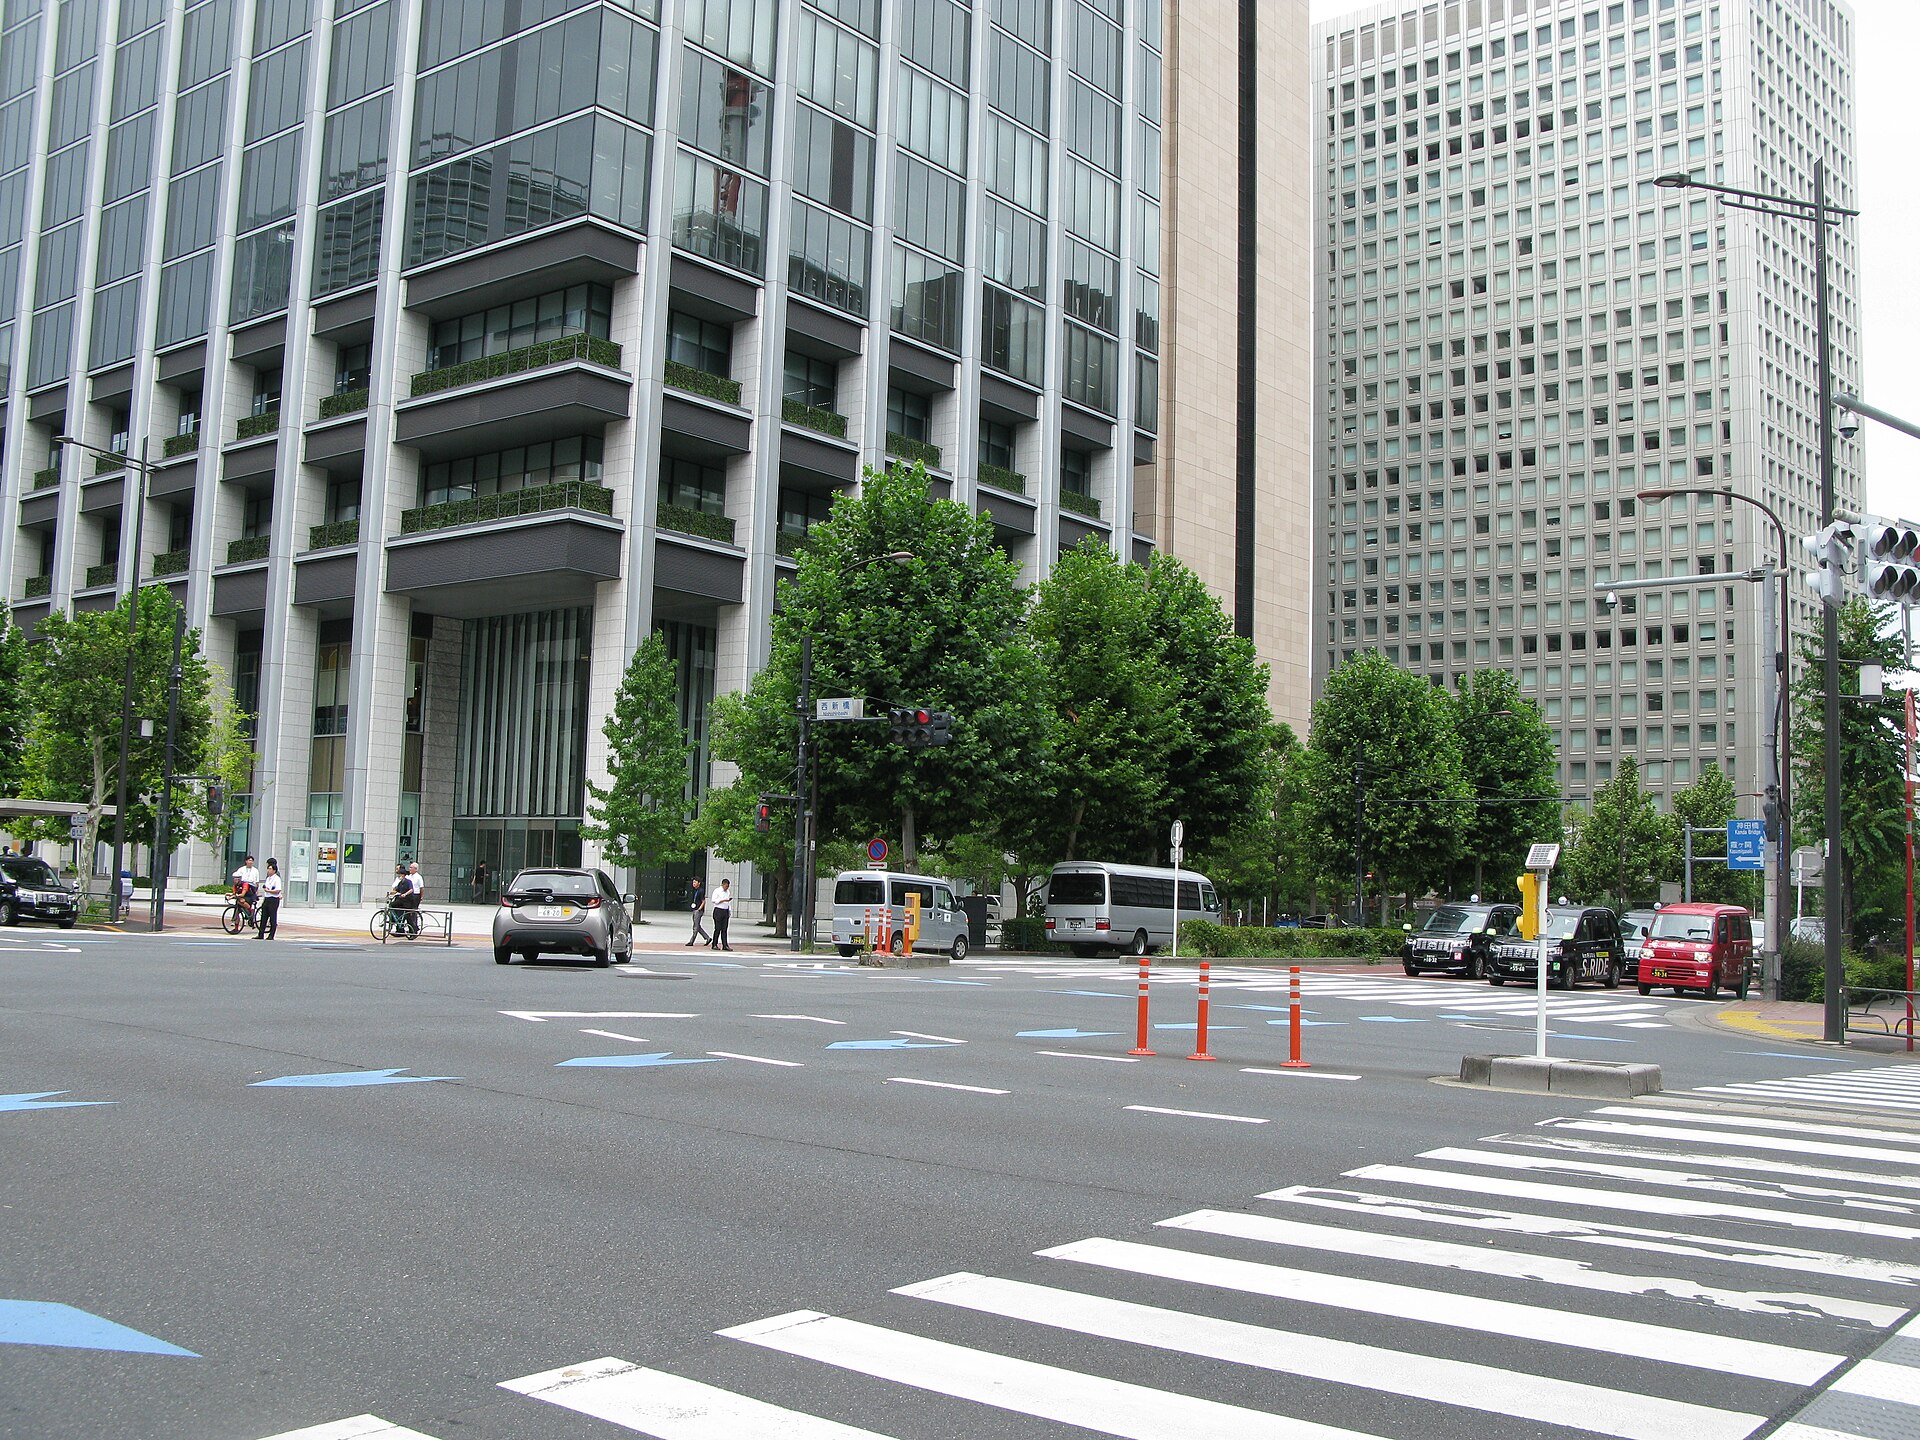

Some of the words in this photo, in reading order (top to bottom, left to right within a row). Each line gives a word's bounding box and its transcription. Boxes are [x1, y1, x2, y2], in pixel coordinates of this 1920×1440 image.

[821, 701, 850, 710] 西新橋
[1736, 822, 1759, 830] 神田橋
